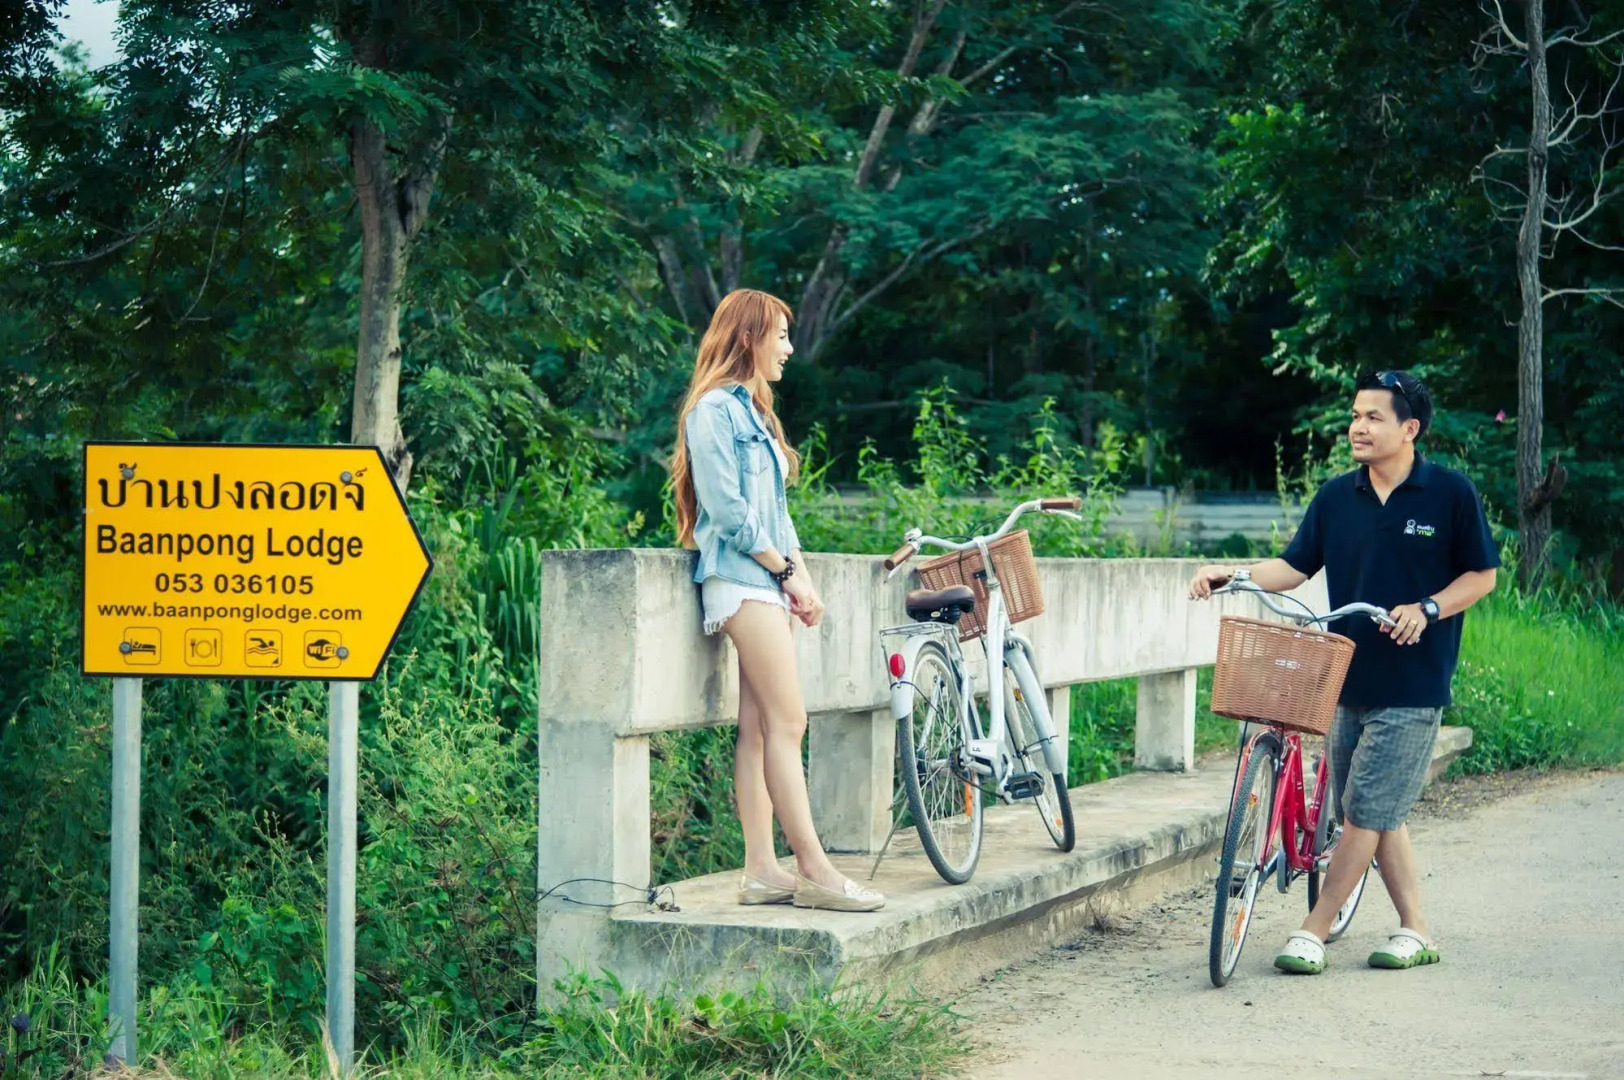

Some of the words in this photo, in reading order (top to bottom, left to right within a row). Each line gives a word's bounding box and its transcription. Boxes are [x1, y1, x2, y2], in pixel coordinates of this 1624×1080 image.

[96, 524, 254, 564] Baanpong
[267, 527, 363, 566] Lodge
[155, 573, 204, 593] 053
[214, 574, 314, 595] 036105
[97, 602, 362, 624] www.baanponglodge.com
